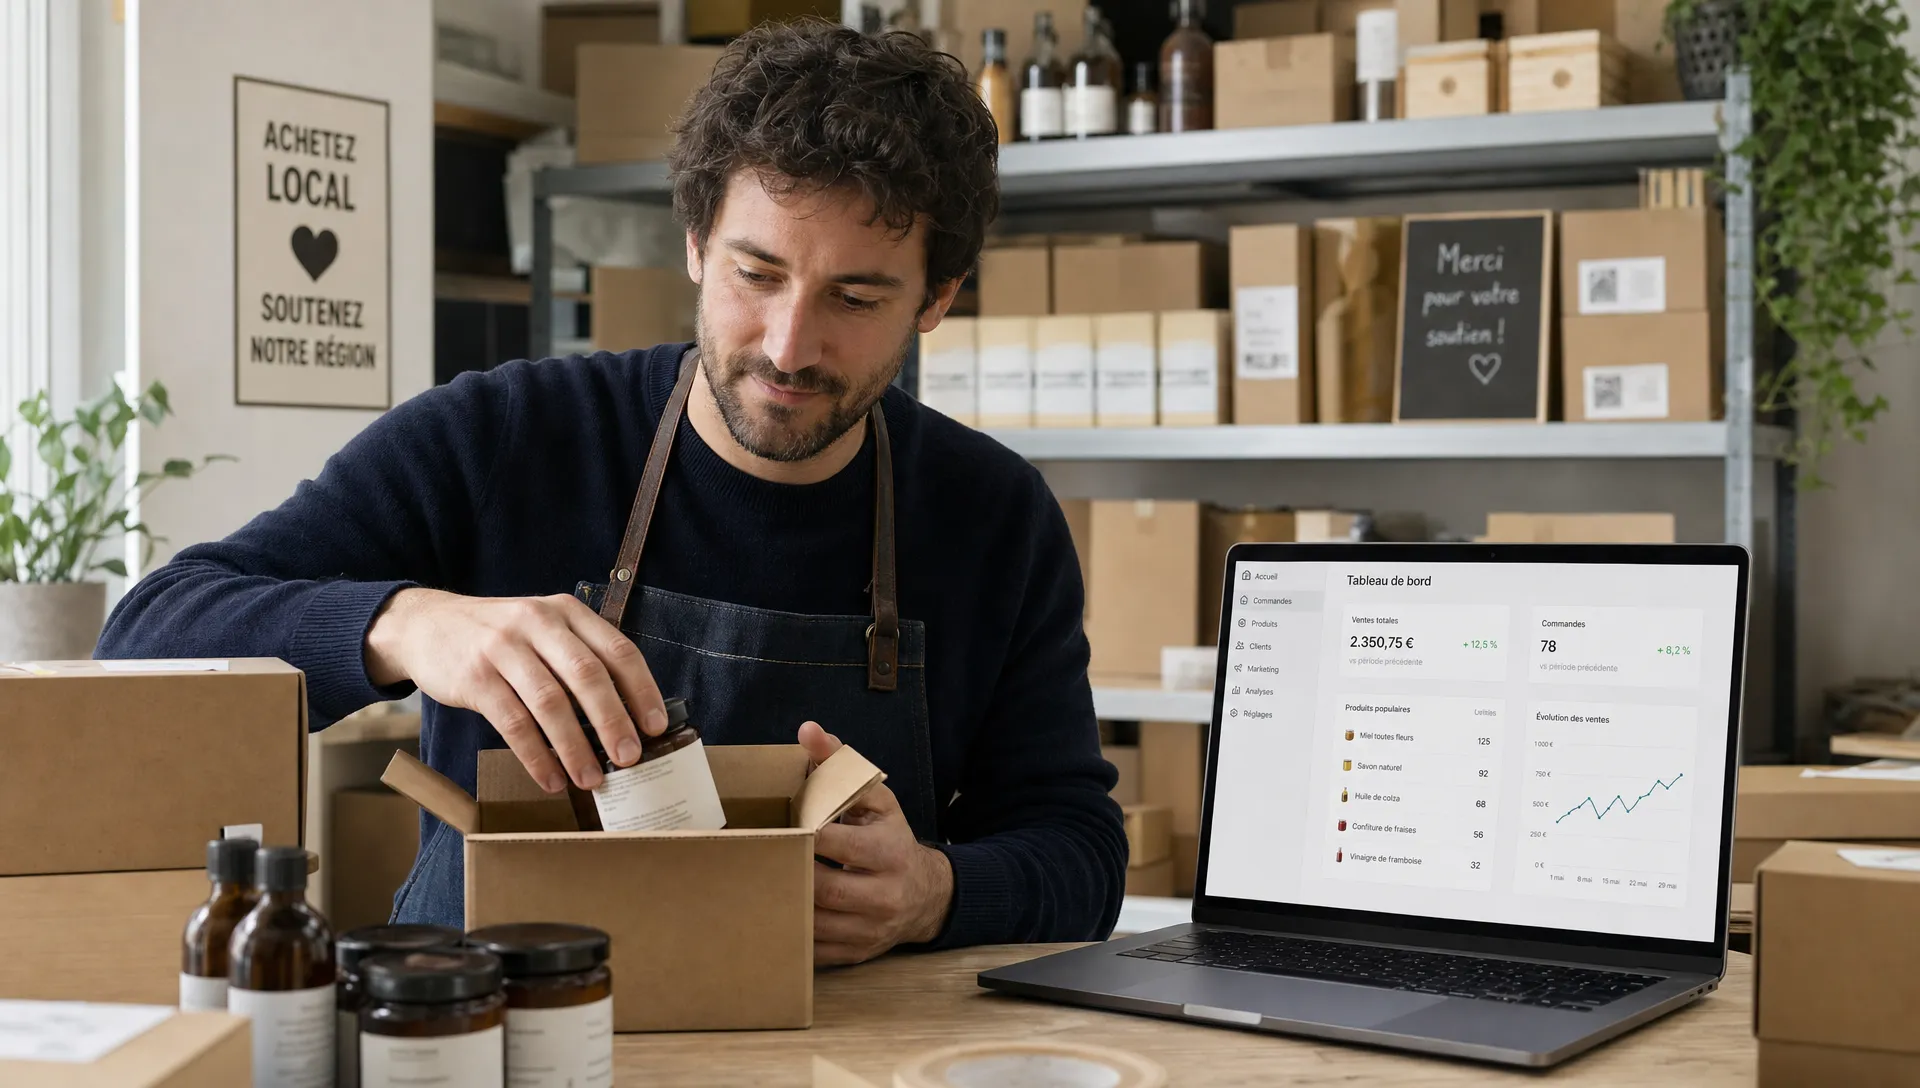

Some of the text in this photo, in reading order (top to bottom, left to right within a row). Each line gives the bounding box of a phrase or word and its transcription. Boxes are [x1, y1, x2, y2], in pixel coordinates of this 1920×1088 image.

[264, 120, 356, 163] ACHETEZ
[267, 163, 355, 212] LOCAL
[1437, 242, 1504, 274] Merci
[1422, 281, 1519, 316] pour votre
[262, 293, 364, 328] SOUTENEZ
[251, 335, 375, 369] NOTRE RÉGION
[1254, 572, 1278, 580] Accueil
[1347, 575, 1432, 586] Tableau de bord
[1253, 597, 1292, 605] Commandes
[1251, 620, 1278, 628] Produits
[1351, 616, 1374, 624] Ventes
[1541, 620, 1586, 628] Commandes
[1350, 636, 1414, 650] 2.350,75 €
[1470, 640, 1488, 650] 12,5
[1490, 641, 1498, 649] %
[1540, 640, 1557, 652] 78
[1666, 646, 1680, 656] 8,2
[1682, 647, 1690, 655] %
[1247, 666, 1279, 674] Marketing
[1549, 663, 1576, 672] période
[1245, 688, 1274, 696] Analyses
[1345, 704, 1410, 714] Produits populaires
[1243, 710, 1273, 719] Réglages
[1536, 712, 1569, 722] Évolution
[1570, 715, 1583, 723] des
[1374, 733, 1395, 741] toutes
[1395, 733, 1414, 741] fleurs
[1478, 770, 1488, 778] 92
[1355, 793, 1371, 801] Huile
[1475, 800, 1486, 808] 68
[1352, 823, 1416, 834] Confiture de fraises
[1350, 853, 1422, 865] Vinaigre de framboise
[1470, 861, 1480, 869] 32
